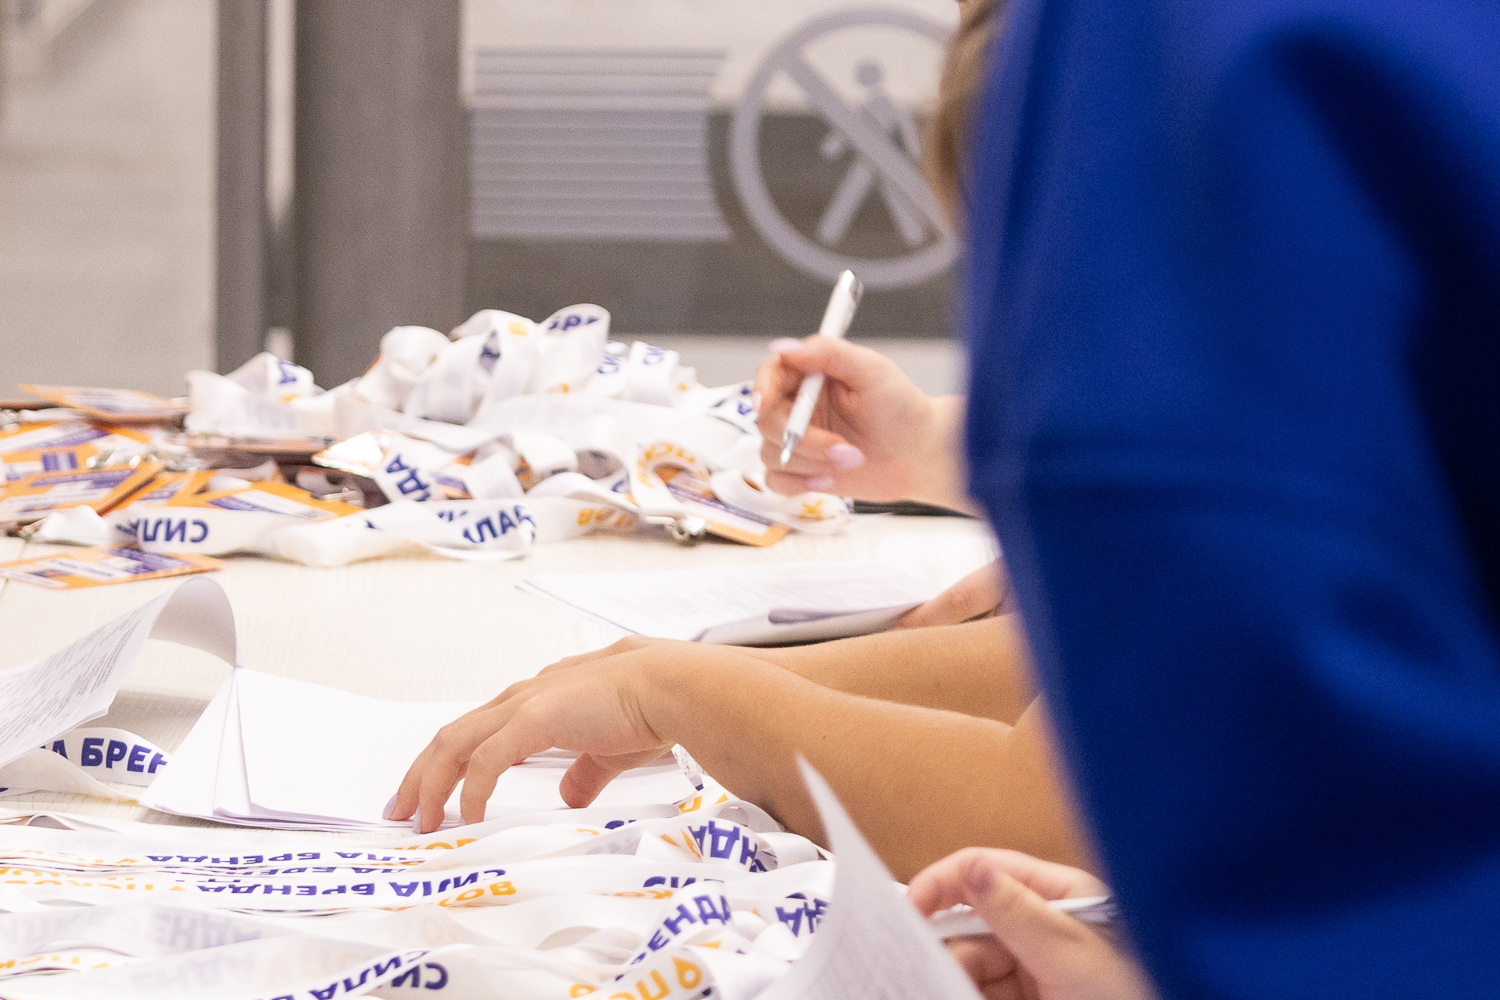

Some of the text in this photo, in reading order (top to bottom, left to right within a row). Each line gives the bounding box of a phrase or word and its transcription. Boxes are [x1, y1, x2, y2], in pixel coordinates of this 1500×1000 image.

[146, 851, 321, 865] БРЕНДА
[196, 882, 376, 896] БРЕНДА
[388, 868, 506, 898] СИЛА
